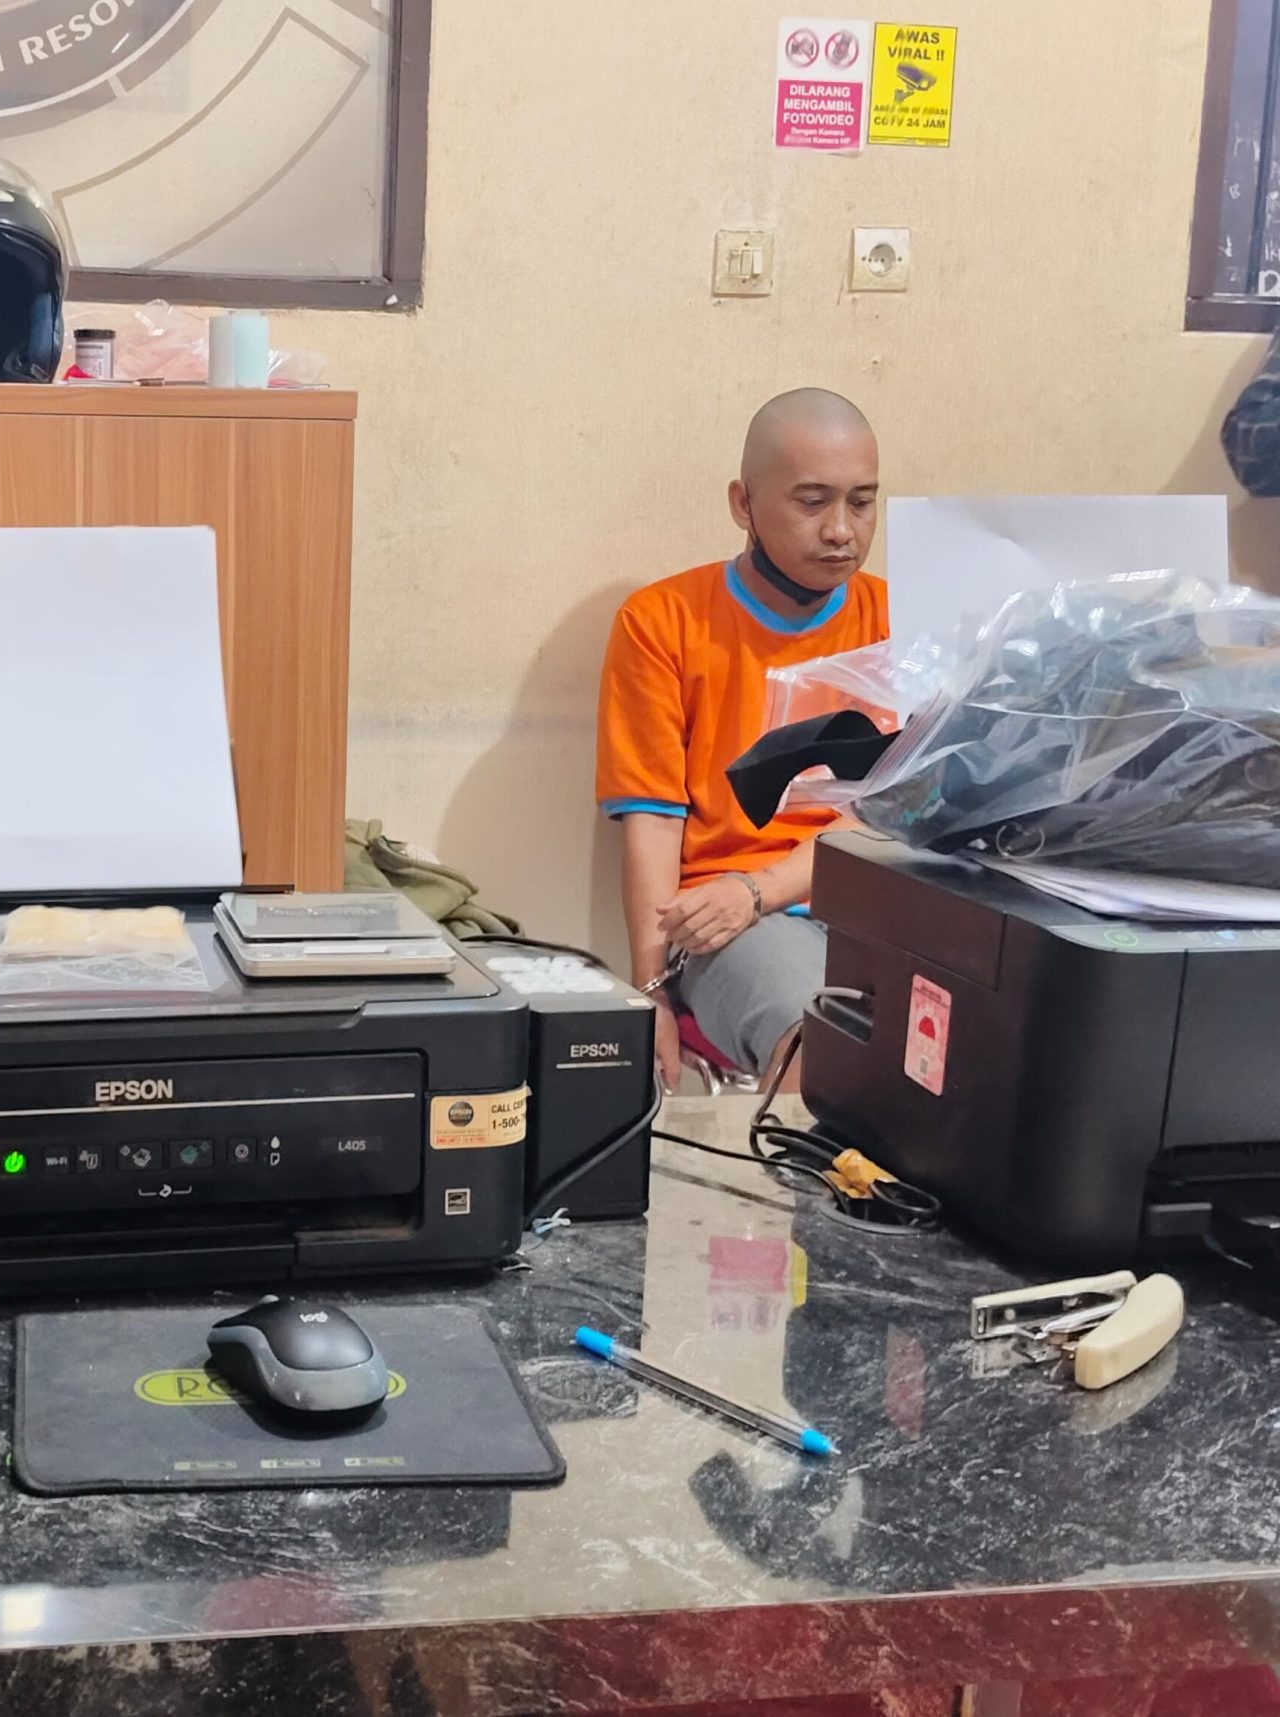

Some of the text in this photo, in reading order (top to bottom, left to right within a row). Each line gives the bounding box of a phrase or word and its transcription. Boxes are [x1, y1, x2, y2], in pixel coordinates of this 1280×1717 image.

[19, 0, 135, 65] RESO
[895, 28, 940, 44] AWAS
[887, 46, 931, 60] VIRAL
[789, 84, 851, 97] DILARANG
[783, 98, 855, 112] MENGAMBIL
[783, 112, 854, 125] FOTO/VIDEO
[906, 118, 920, 128] 24
[923, 119, 946, 129] JAM
[570, 1043, 619, 1058] EPSON
[95, 1079, 173, 1102] EPSON
[491, 1103, 511, 1114] CALL
[338, 1139, 367, 1152] L405
